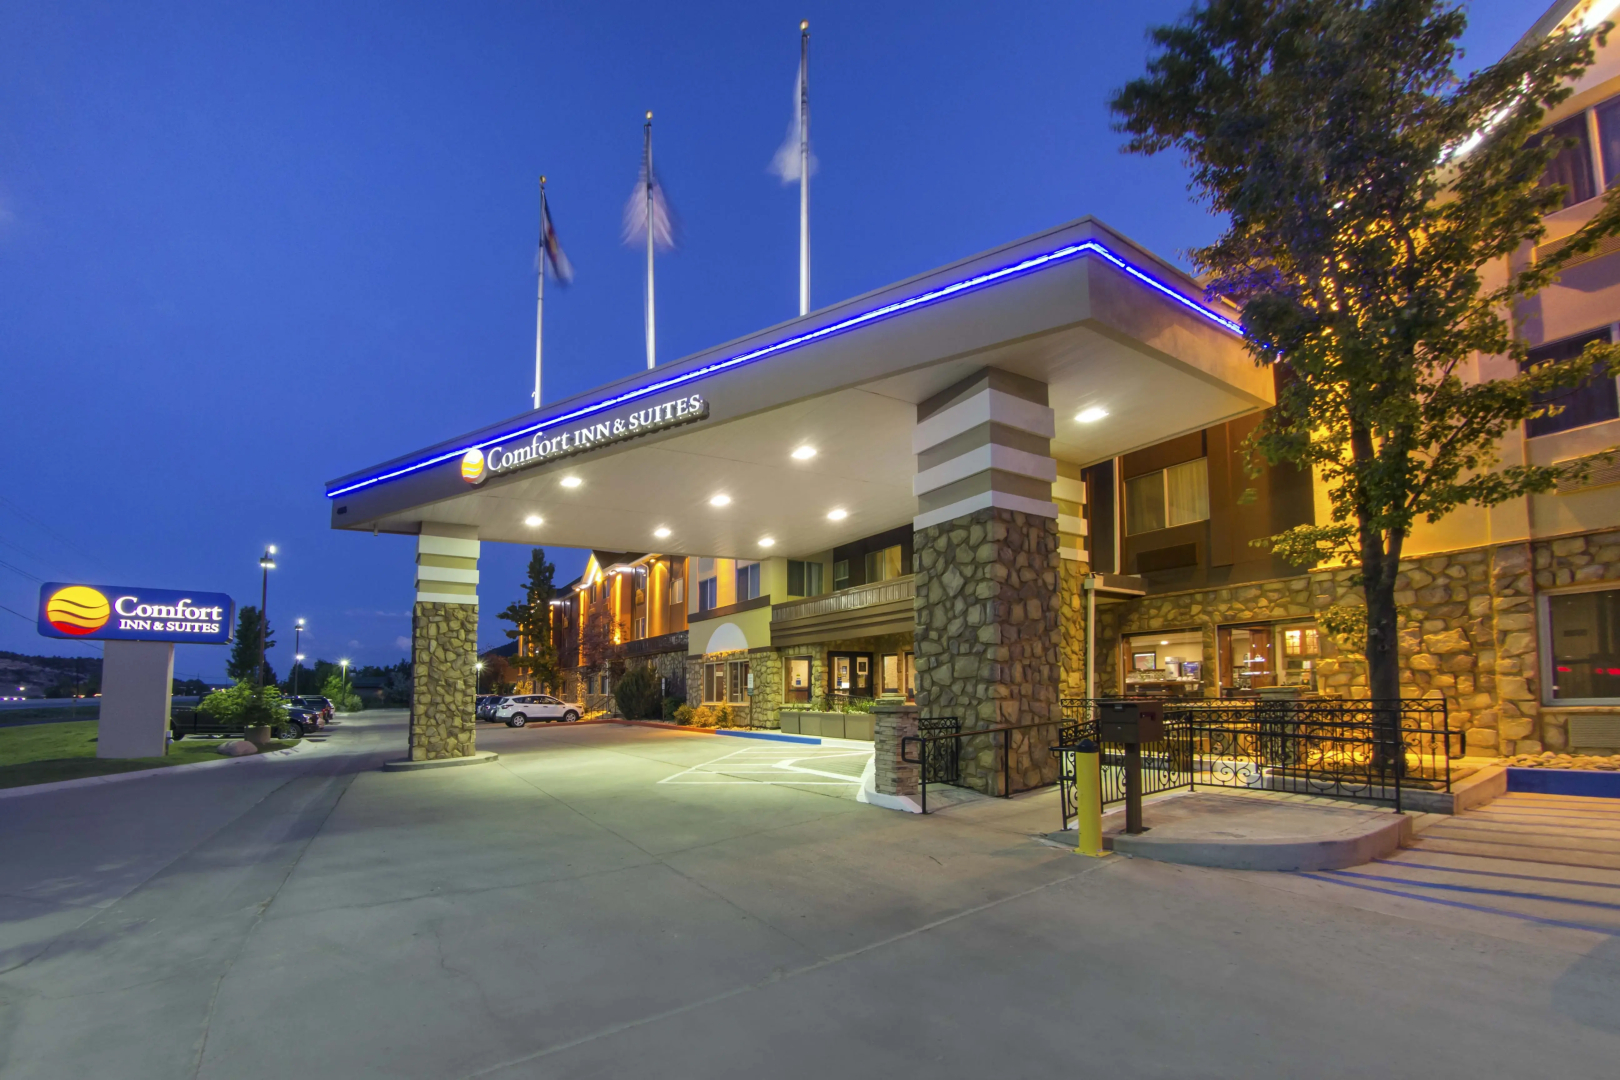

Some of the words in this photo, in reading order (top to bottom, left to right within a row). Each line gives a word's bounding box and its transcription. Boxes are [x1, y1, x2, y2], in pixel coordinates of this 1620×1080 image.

[487, 431, 571, 471] Comfort
[574, 421, 610, 445] INN
[612, 418, 626, 433] &
[629, 394, 700, 430] SUITES
[114, 596, 223, 620] Comfort
[119, 619, 151, 630] INN
[153, 621, 164, 631] &
[166, 622, 219, 633] SUITES
